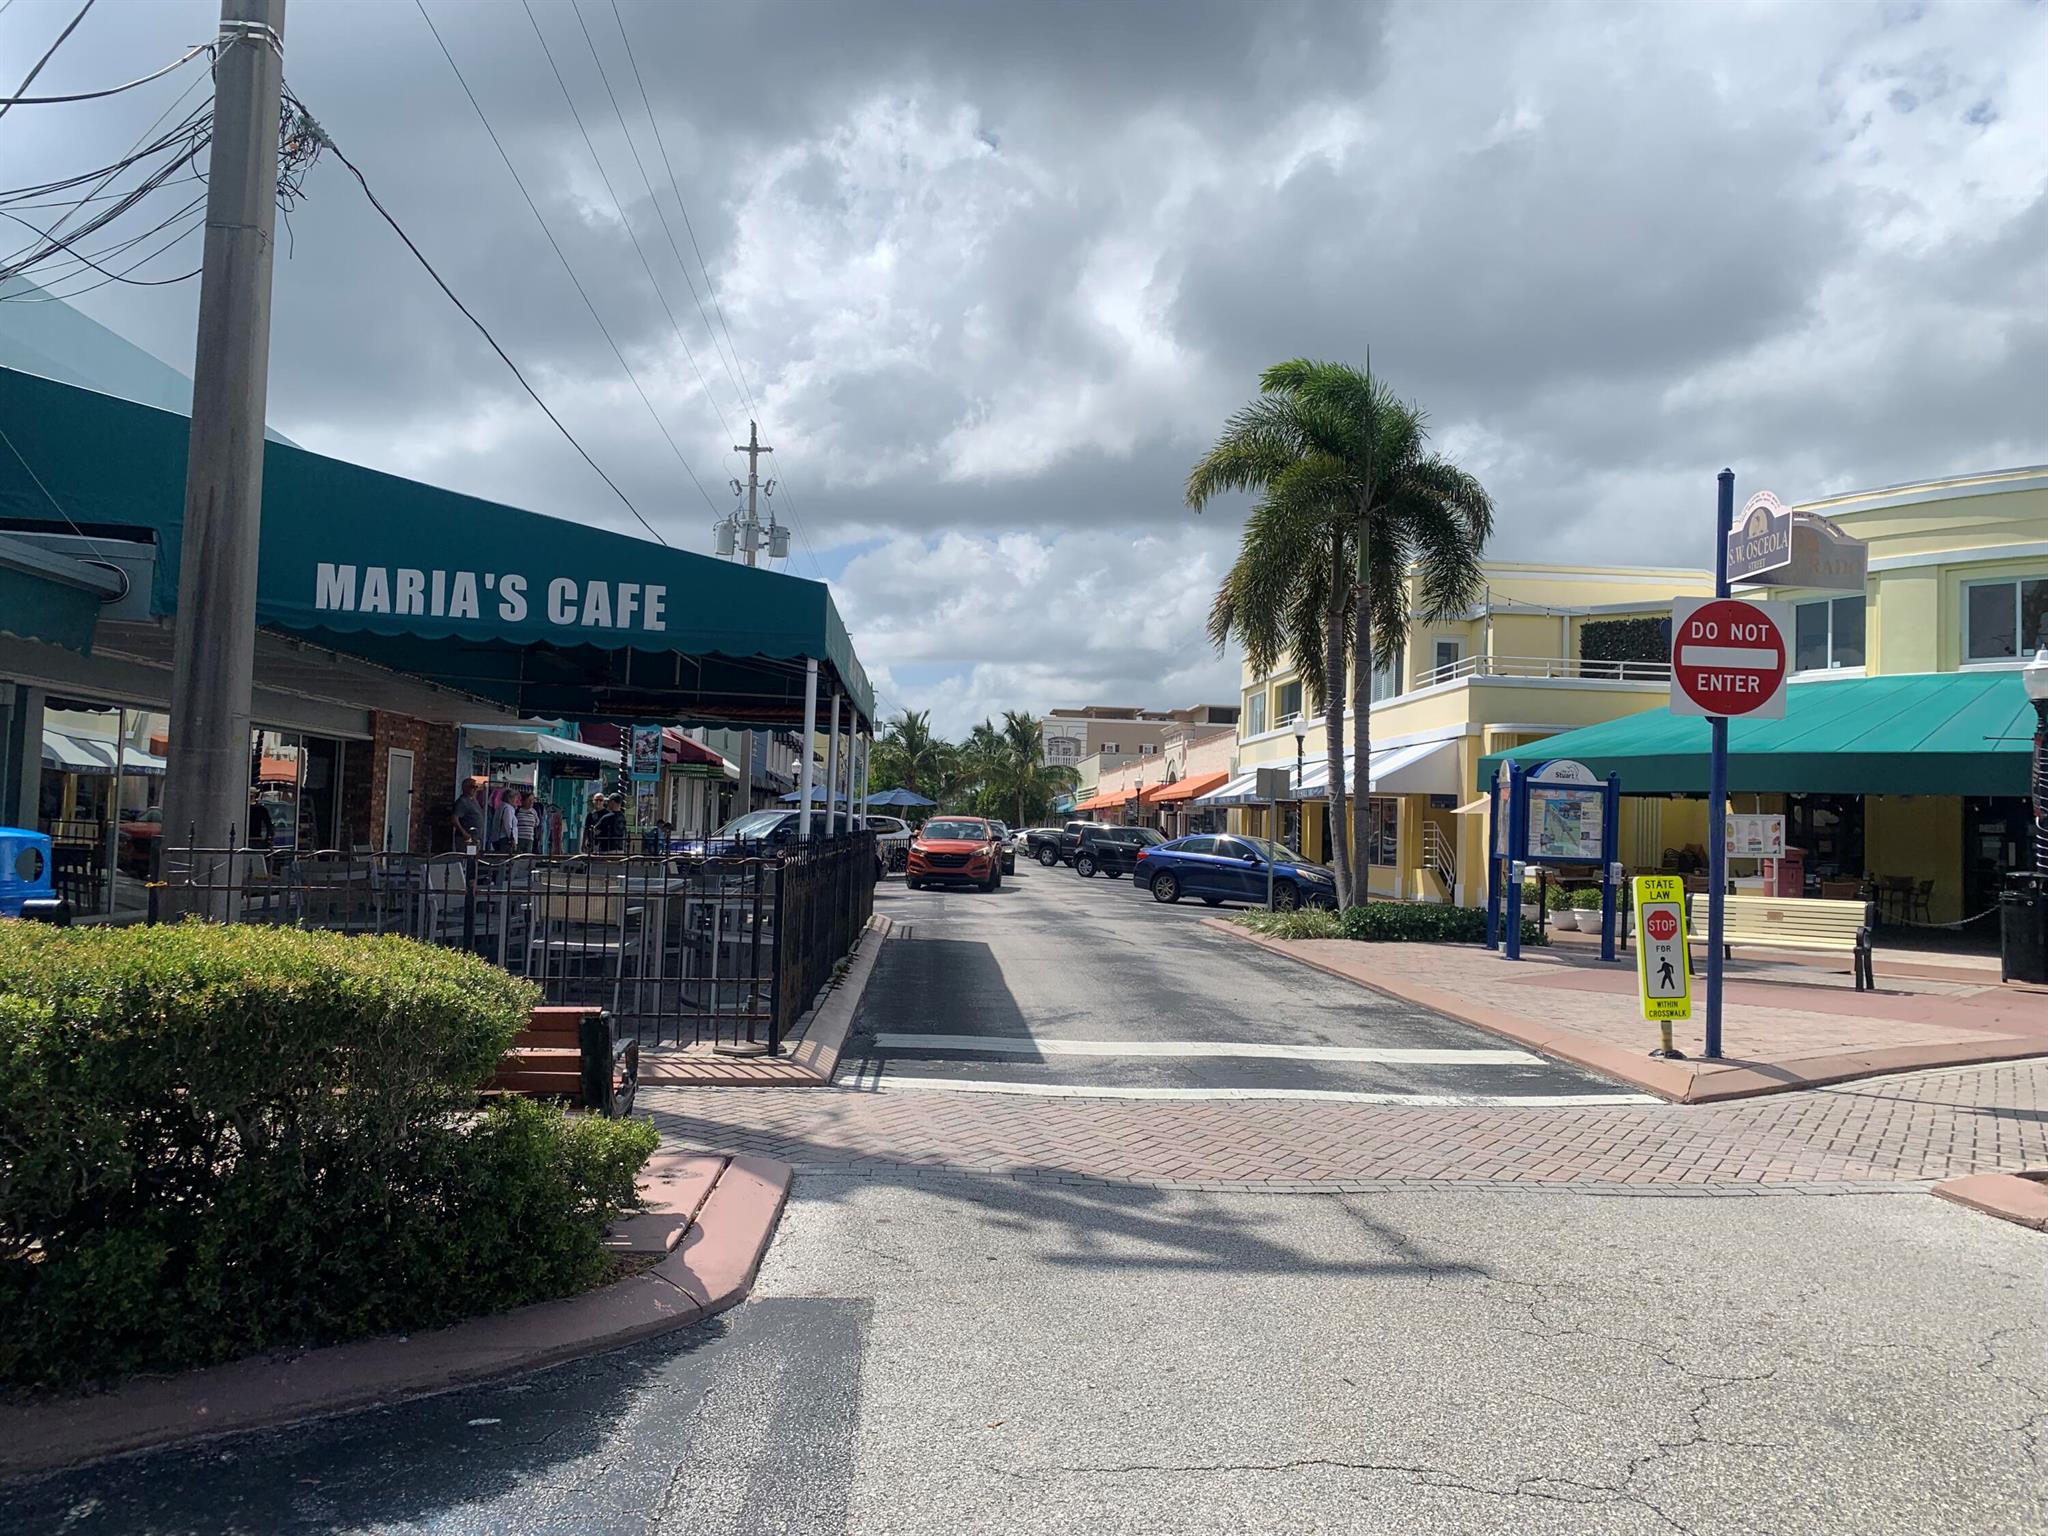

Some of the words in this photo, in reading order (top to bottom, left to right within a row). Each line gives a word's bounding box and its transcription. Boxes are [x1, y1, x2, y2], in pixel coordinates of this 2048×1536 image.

[1746, 530, 1788, 560] OSCEOLA
[1748, 557, 1766, 570] STREET
[315, 562, 528, 623] MARIA'S
[547, 577, 666, 632] CAFE
[1691, 621, 1718, 639] DO
[1730, 623, 1769, 642] NOT
[1697, 673, 1760, 693] ENTER
[1555, 770, 1575, 780] Stuart
[1644, 879, 1675, 889] STATE
[1649, 890, 1670, 900] LAW
[1648, 918, 1677, 932] STOP
[1655, 944, 1672, 953] FOR
[1656, 1000, 1679, 1009] WITHIN
[1648, 1008, 1687, 1018] CROSSWALK
